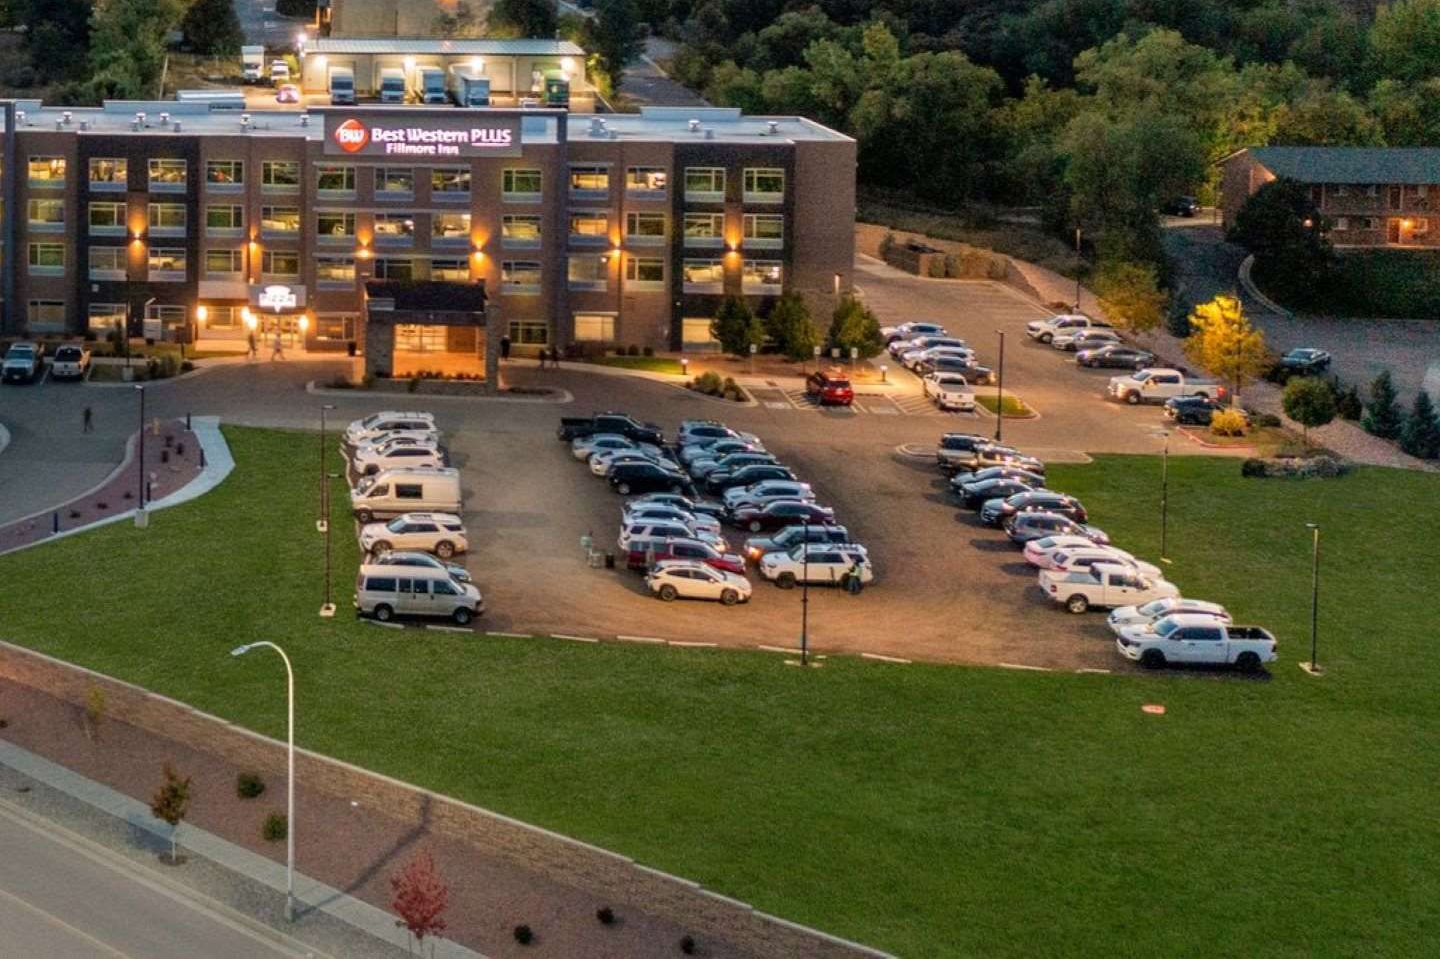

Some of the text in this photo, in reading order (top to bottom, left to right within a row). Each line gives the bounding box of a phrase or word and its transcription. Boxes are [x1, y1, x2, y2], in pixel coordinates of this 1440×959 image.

[371, 128, 512, 143] Best Western PLUS
[386, 142, 459, 155] Fillmore Inn
